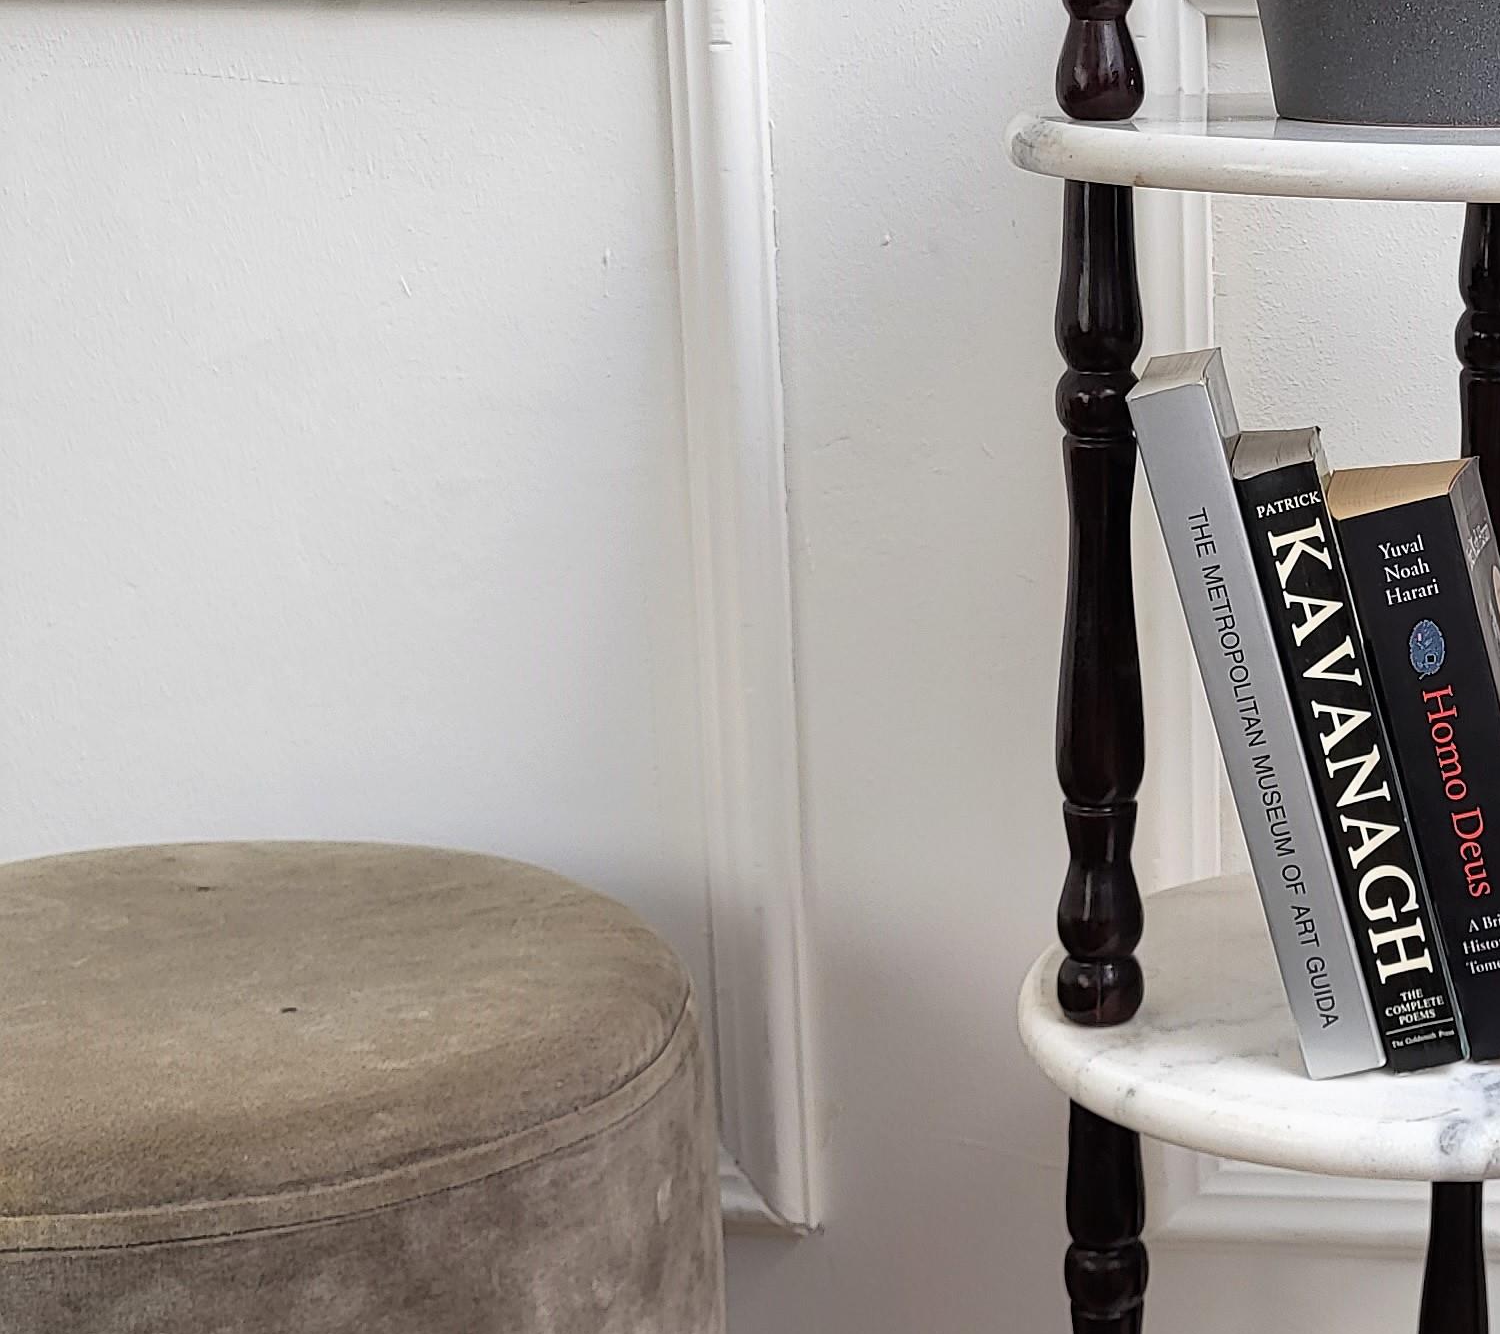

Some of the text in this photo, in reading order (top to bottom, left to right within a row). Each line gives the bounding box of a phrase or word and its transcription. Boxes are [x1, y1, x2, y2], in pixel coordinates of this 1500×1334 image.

[1256, 491, 1321, 518] PATRICK
[1378, 534, 1424, 559] Yuval
[1384, 558, 1430, 582] Noah
[1385, 578, 1440, 605] Harari
[1268, 518, 1433, 984] KAVANAGH
[1188, 507, 1339, 1028] THE METROPOLITAN MUSEUM OF ART GUIDA
[1422, 685, 1491, 897] Homo Deus
[1468, 919, 1479, 932] A
[1385, 995, 1444, 1017] COMPLETE
[1400, 988, 1423, 1001] THE
[1399, 1008, 1436, 1025] POEMS
